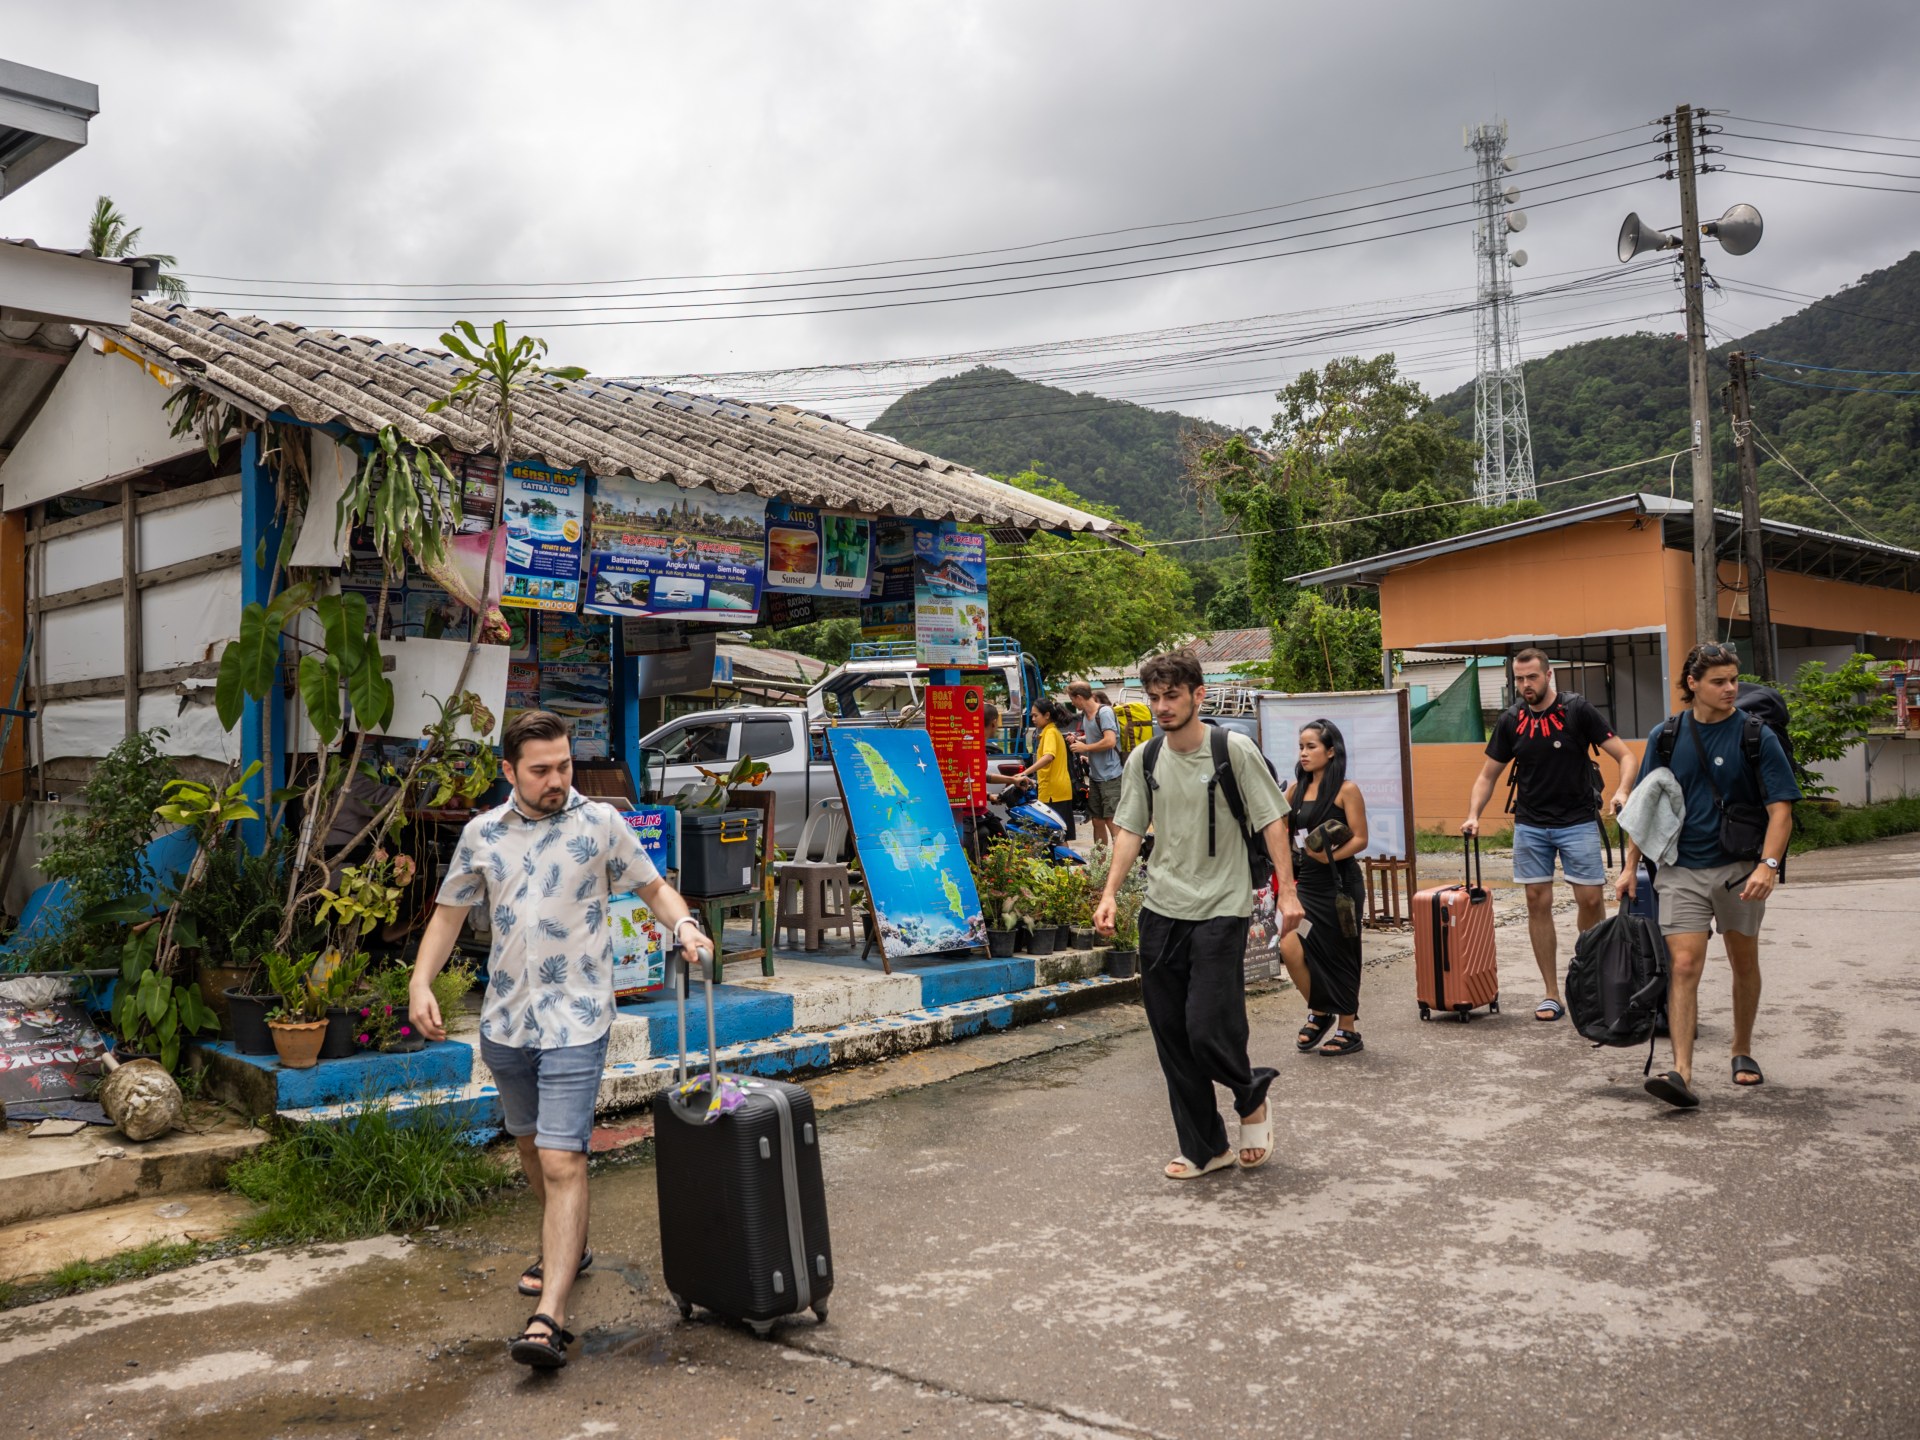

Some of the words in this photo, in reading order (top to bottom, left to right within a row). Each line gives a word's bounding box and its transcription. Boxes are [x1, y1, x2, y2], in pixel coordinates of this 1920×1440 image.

[522, 482, 548, 492] SATTRA
[550, 486, 568, 495] TOUR
[622, 534, 667, 548] BOONSIRI
[944, 534, 983, 546] SORKELING
[611, 556, 649, 567] Battambang
[666, 560, 687, 570] Angkor
[688, 562, 700, 571] Wat
[717, 565, 731, 573] Siem
[732, 567, 747, 575] Reap
[782, 573, 806, 585] Sunset
[834, 578, 854, 589] Squid
[787, 594, 812, 608] RAYANG
[790, 606, 811, 620] KOOD
[932, 690, 953, 701] BOAT
[932, 701, 953, 710] TRIPS
[647, 827, 662, 841] day
[5, 1040, 31, 1048] NIGHT
[33, 1038, 62, 1046] FRIDAY
